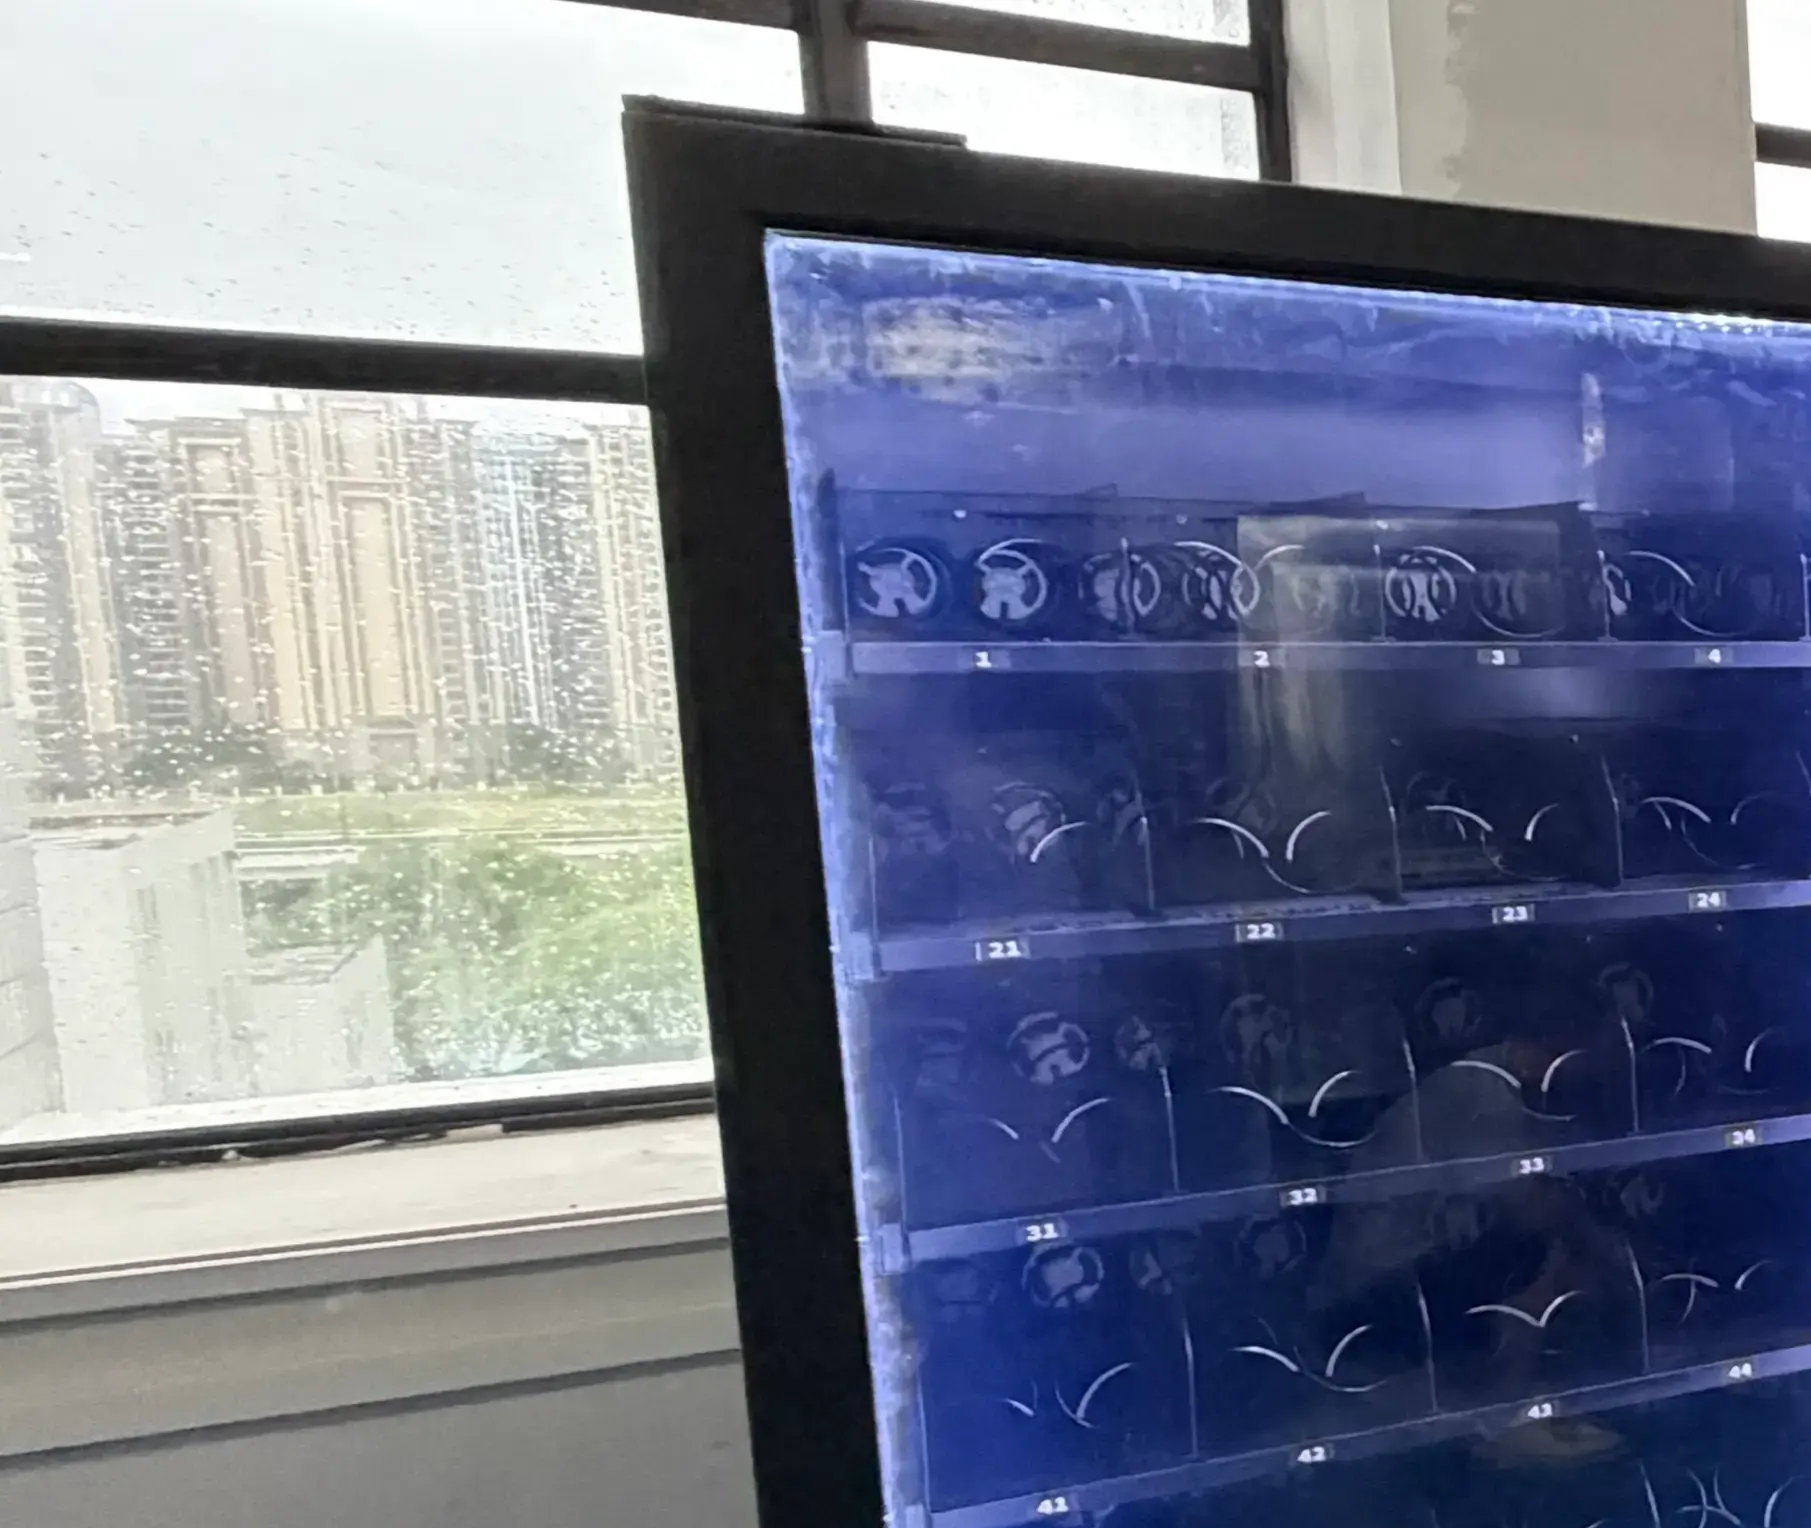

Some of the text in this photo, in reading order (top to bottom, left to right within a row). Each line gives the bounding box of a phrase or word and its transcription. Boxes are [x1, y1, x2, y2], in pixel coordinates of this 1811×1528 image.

[976, 651, 992, 668] 1
[1254, 650, 1270, 667] 2
[1491, 649, 1505, 665] 3
[1708, 648, 1722, 664] 4
[988, 940, 1022, 958] 21
[1247, 923, 1276, 940] 22
[1502, 906, 1528, 922] 23
[1697, 892, 1721, 908] 24
[1026, 1223, 1059, 1241] 31
[1289, 1187, 1318, 1205] 32
[1037, 1496, 1069, 1515] 41
[1297, 1446, 1326, 1463] 42
[1527, 1403, 1553, 1419] 43
